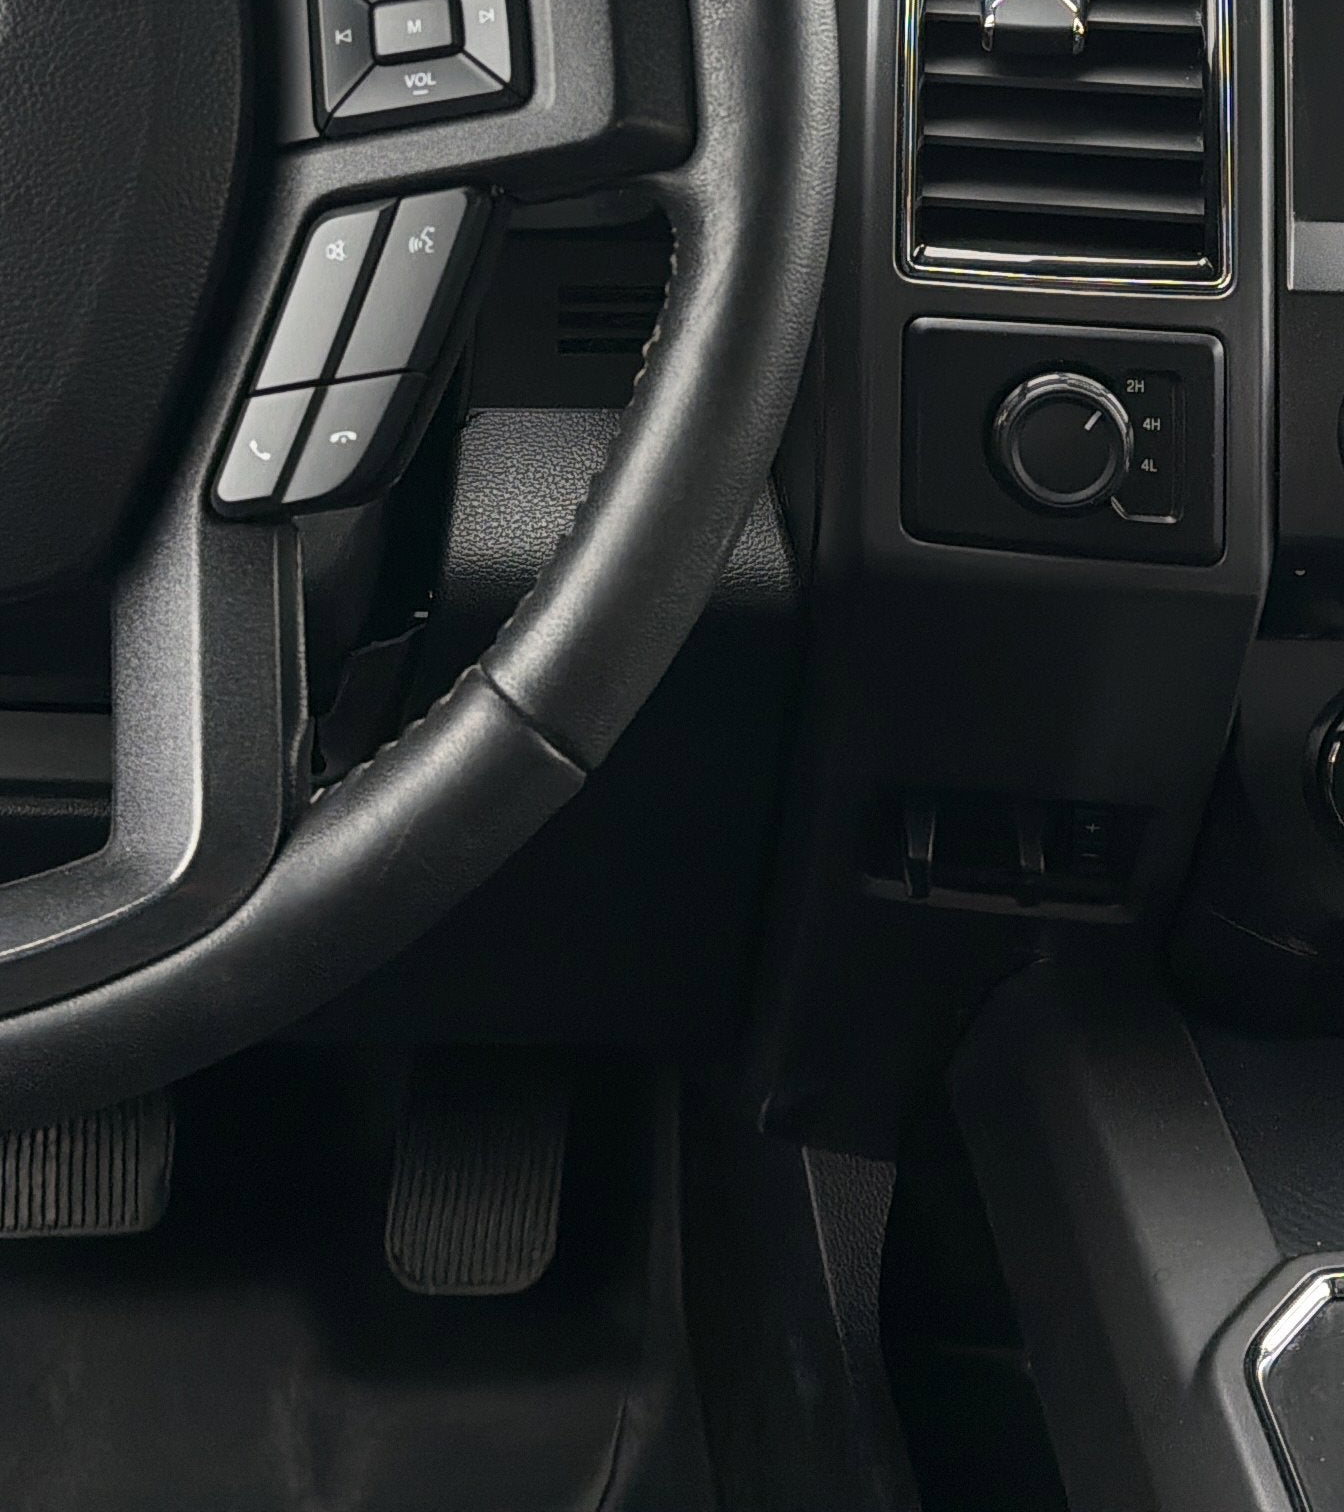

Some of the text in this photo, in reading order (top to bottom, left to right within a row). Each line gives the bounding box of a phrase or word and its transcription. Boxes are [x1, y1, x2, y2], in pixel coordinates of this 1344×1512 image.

[406, 19, 422, 34] M
[405, 72, 437, 88] VOL
[1126, 379, 1145, 393] 2H
[1142, 418, 1161, 432] 4H
[1140, 458, 1158, 473] 4L
